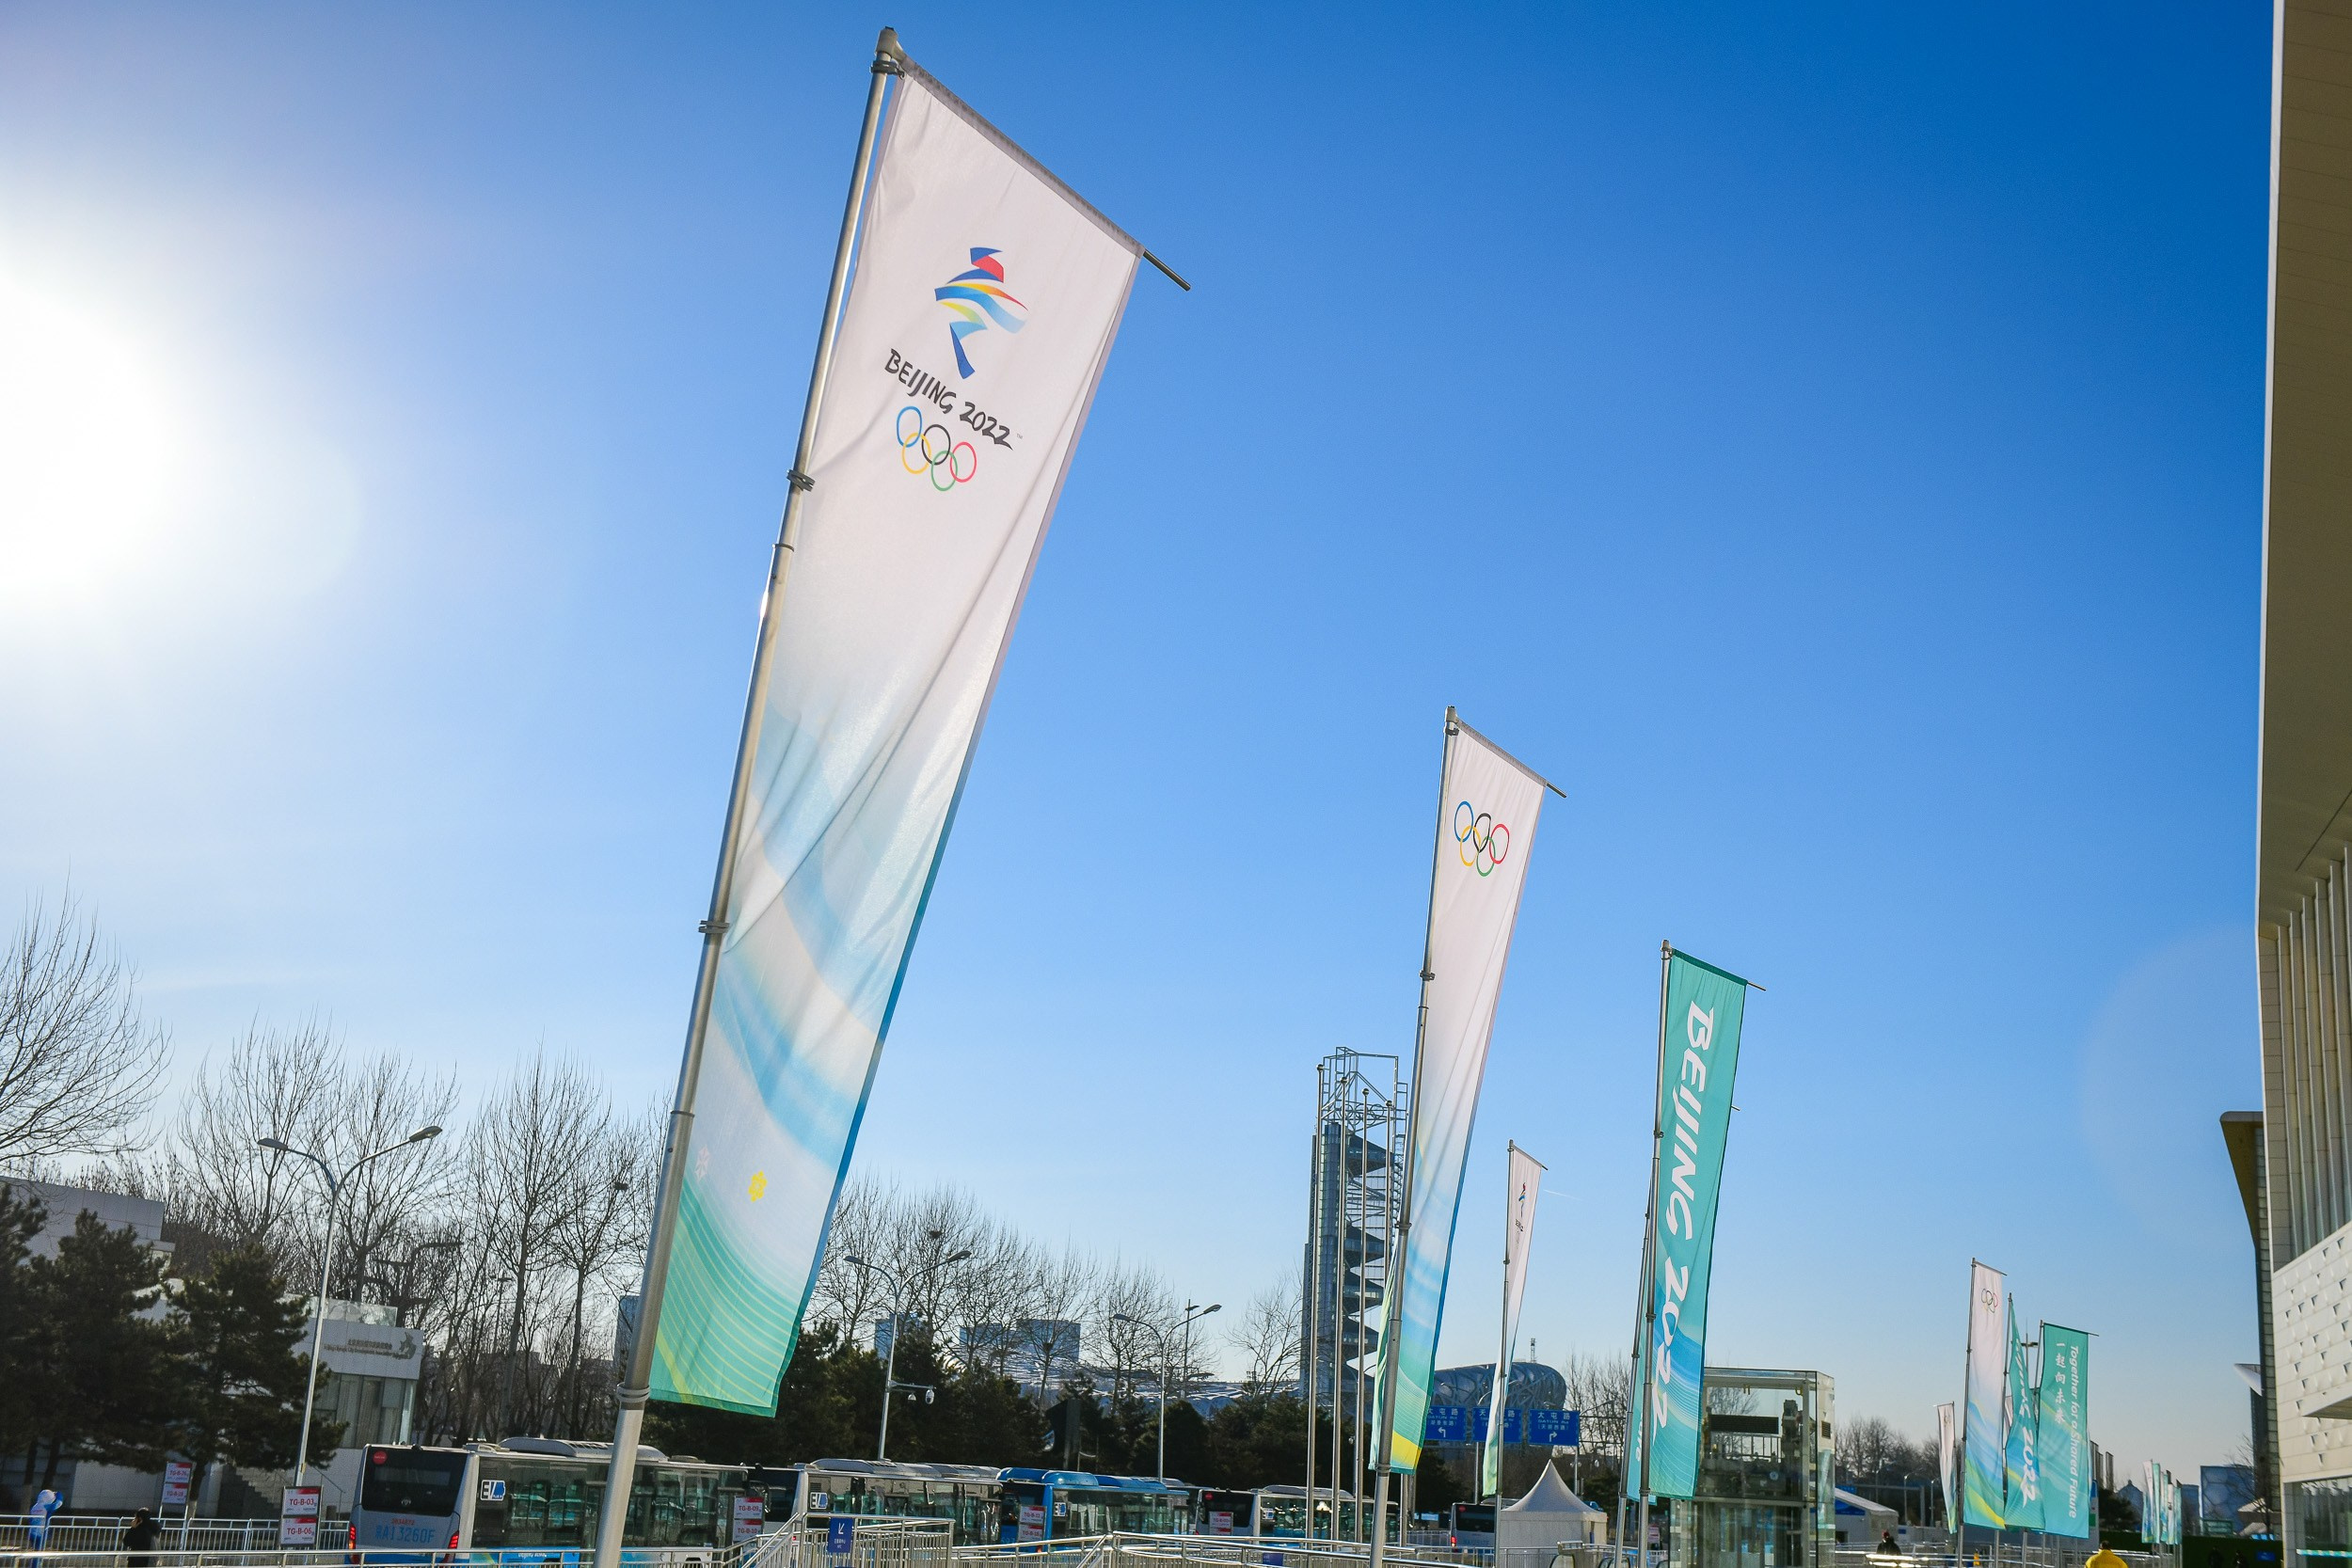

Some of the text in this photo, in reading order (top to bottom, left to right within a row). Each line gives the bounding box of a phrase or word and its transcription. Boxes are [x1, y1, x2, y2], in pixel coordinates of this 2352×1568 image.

[884, 348, 957, 415] BEIJING
[960, 401, 1013, 451] 2022
[1652, 1000, 1714, 1446] BEIJING 2022
[1537, 1411, 1571, 1420] 大屯路
[2055, 1342, 2066, 1424] 一起向未来
[2020, 1426, 2036, 1509] 2022
[2069, 1345, 2080, 1519] Together for a Shared Future
